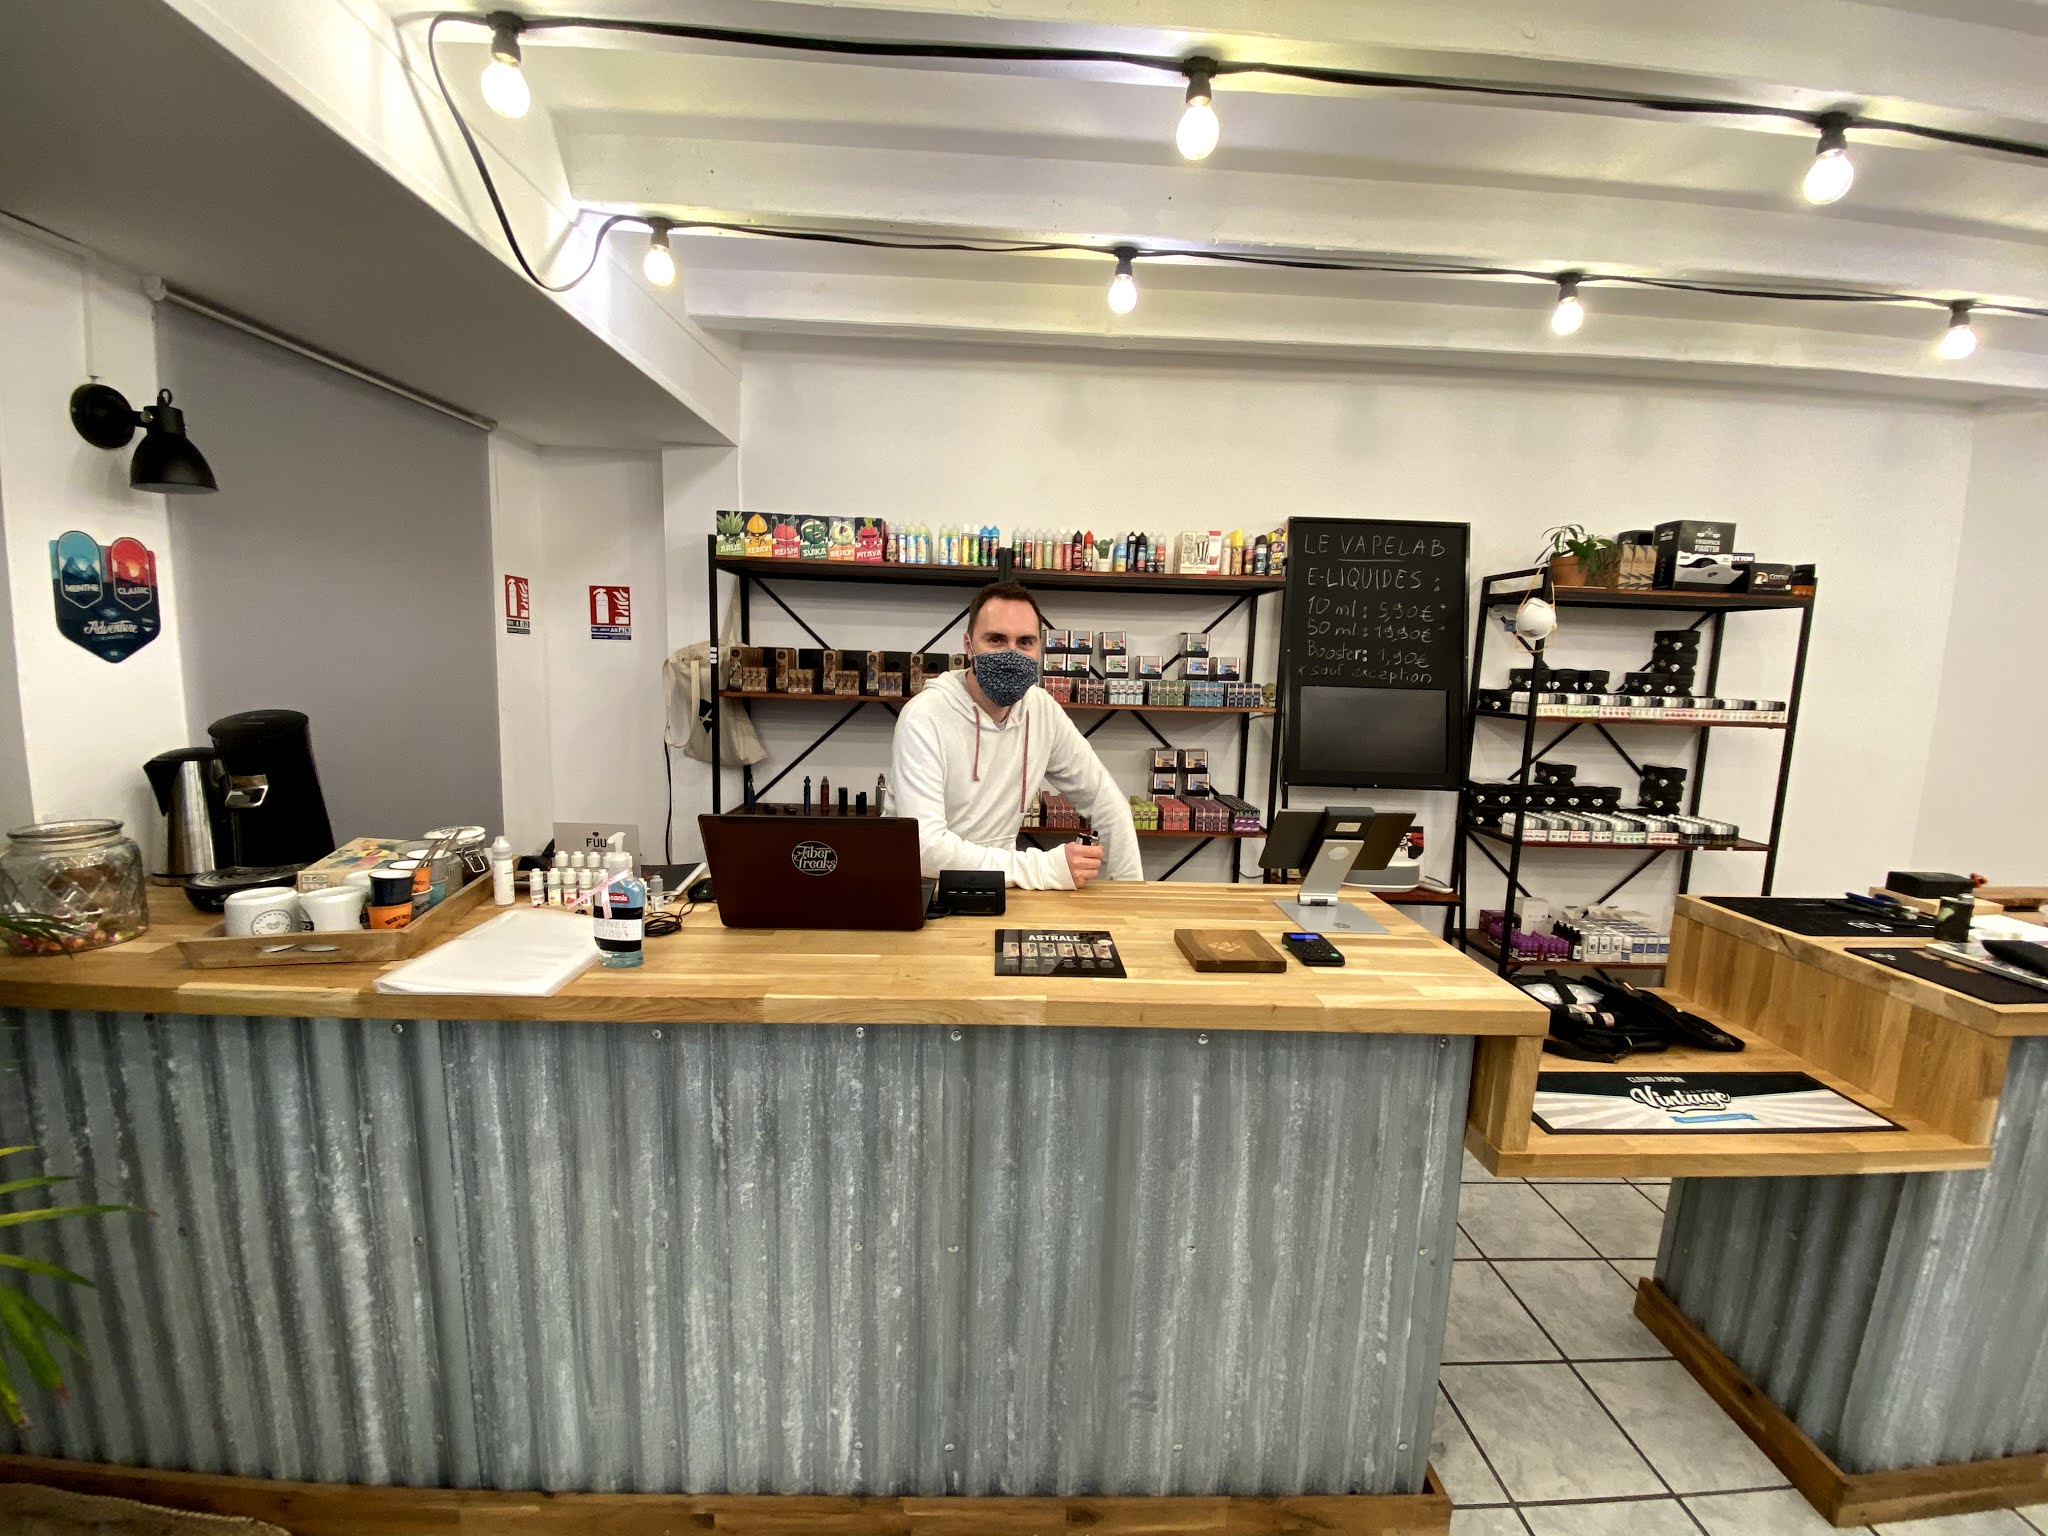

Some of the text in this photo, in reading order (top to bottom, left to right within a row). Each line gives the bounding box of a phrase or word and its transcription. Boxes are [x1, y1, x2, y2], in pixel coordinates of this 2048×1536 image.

[774, 547, 798, 556] REISHI
[803, 547, 827, 557] SUIKA
[1304, 534, 1446, 557] LE VAPELAB
[856, 549, 882, 559] PITAYA
[1307, 567, 1422, 591] E-LIQUIDES
[117, 587, 149, 595] CLASSIC
[1307, 595, 1330, 615] 10
[83, 619, 139, 635] Adventure
[1307, 619, 1330, 636] 50
[1376, 648, 1430, 669] 1,90€
[586, 838, 607, 848] FUU
[794, 845, 832, 860] Fiber
[609, 894, 628, 902] sanis
[1028, 933, 1081, 942] ASTRALE
[1629, 1084, 1731, 1113] Vintage
